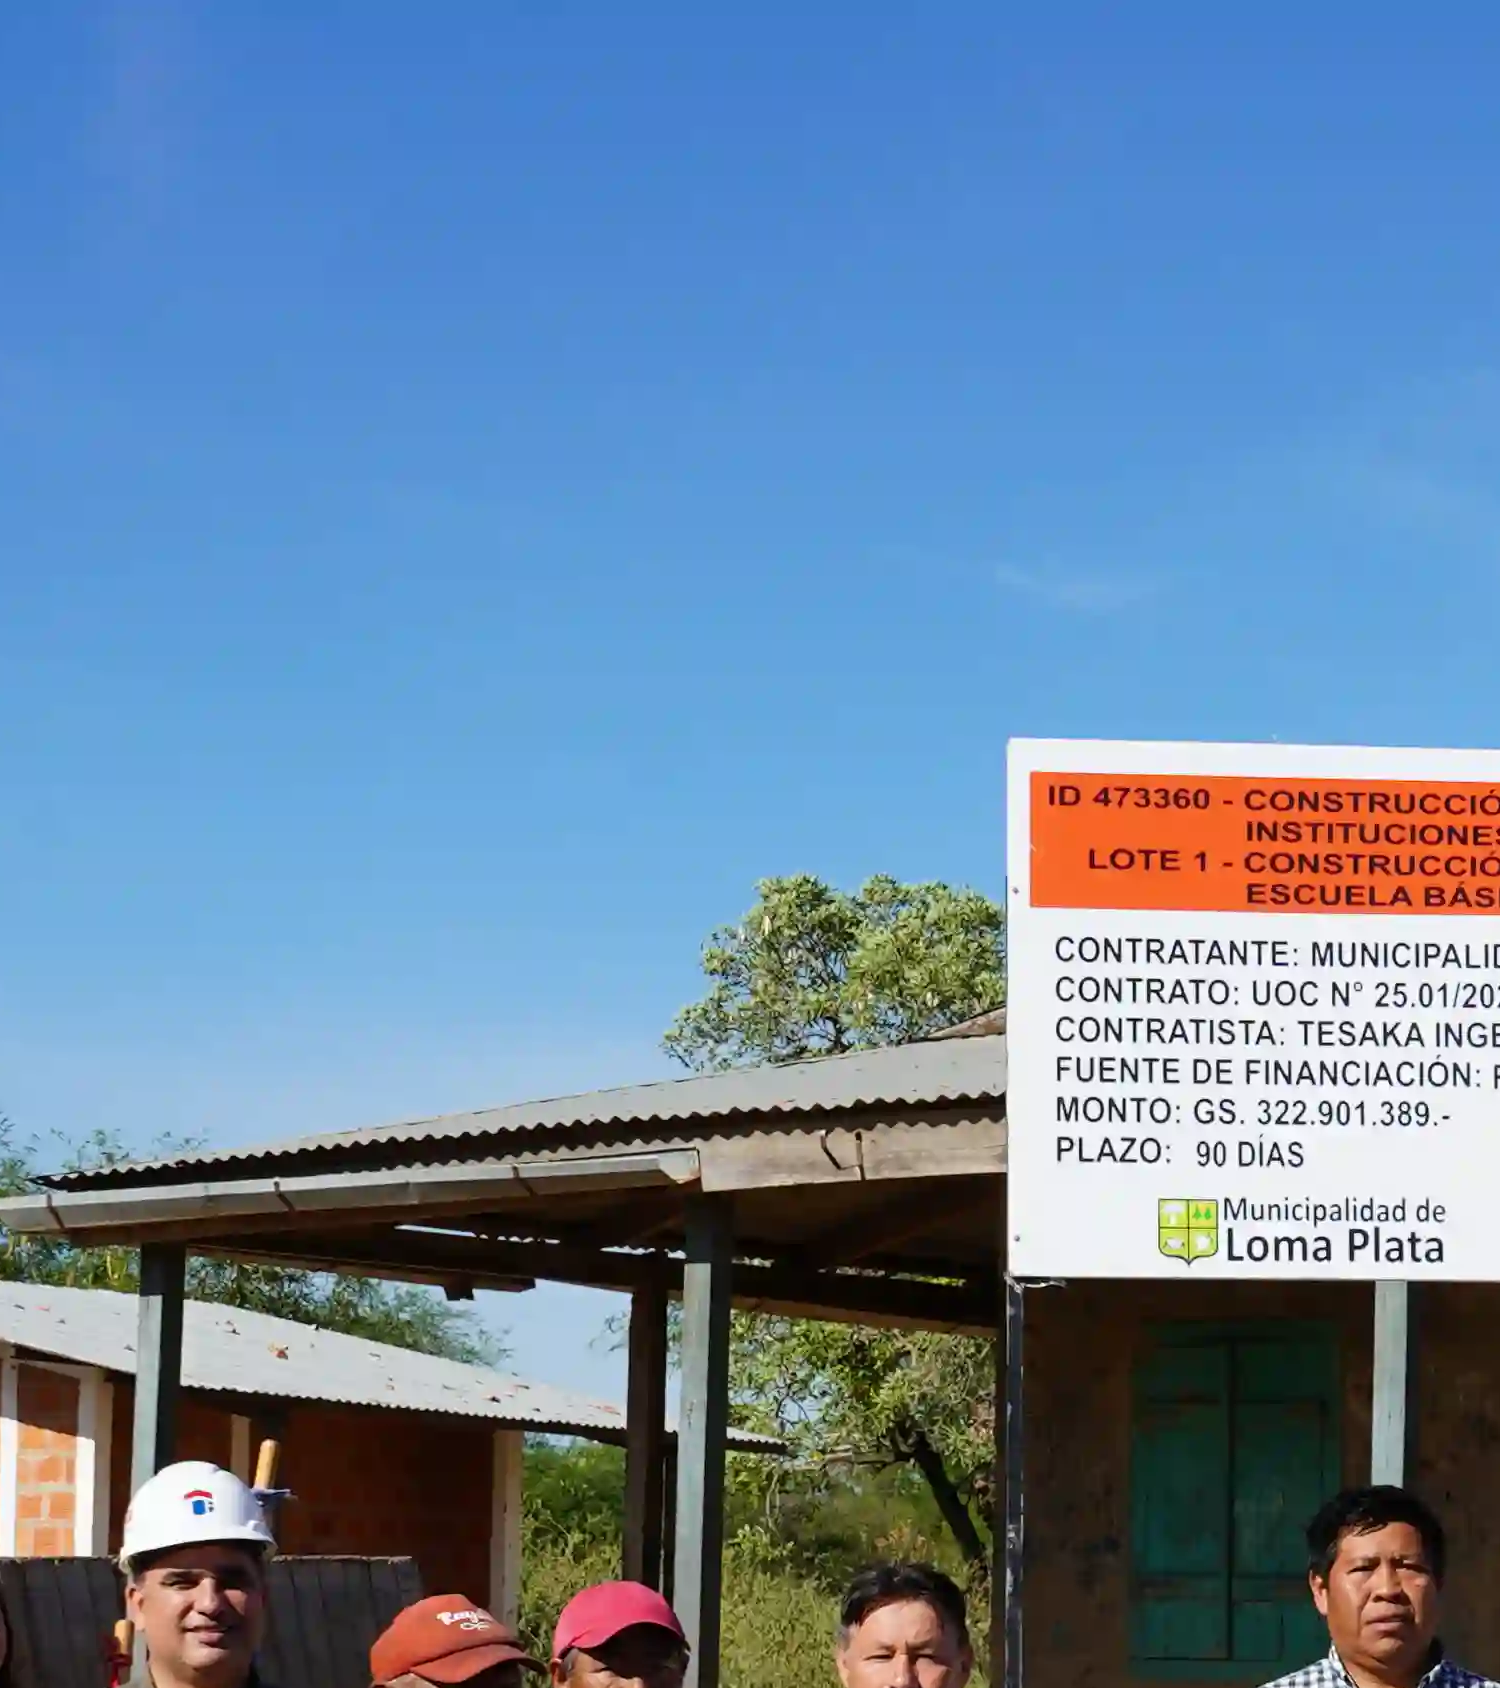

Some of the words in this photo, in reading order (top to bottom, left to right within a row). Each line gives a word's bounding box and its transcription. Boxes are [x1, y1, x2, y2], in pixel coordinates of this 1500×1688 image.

[1049, 785, 1081, 806] ID
[1093, 787, 1210, 809] 473360
[1089, 848, 1178, 871] LOTE
[1195, 851, 1206, 872] 1
[1246, 883, 1413, 907] ESCUELA
[1055, 935, 1298, 967] CONTRATANTE:
[1055, 975, 1239, 1006] CONTRATO:
[1252, 980, 1319, 1007] UOC
[1055, 1015, 1285, 1046] CONTRATISTA:
[1297, 1020, 1425, 1048] TESAKA
[1056, 1056, 1181, 1084] FUENTE
[1192, 1058, 1233, 1085] DE
[1245, 1054, 1481, 1088] FINANCIACIÓN:
[1056, 1096, 1181, 1124] MONTO:
[1193, 1098, 1245, 1125] GS.
[1257, 1099, 1450, 1127] 322.901.389.-
[1056, 1136, 1171, 1164] PLAZO:
[1196, 1140, 1227, 1168] 90
[1238, 1133, 1304, 1169] DÍAS
[1223, 1196, 1406, 1228] Municipalidad
[1416, 1198, 1446, 1223] de
[1227, 1227, 1332, 1263] Loma
[1348, 1226, 1444, 1264] Plata
